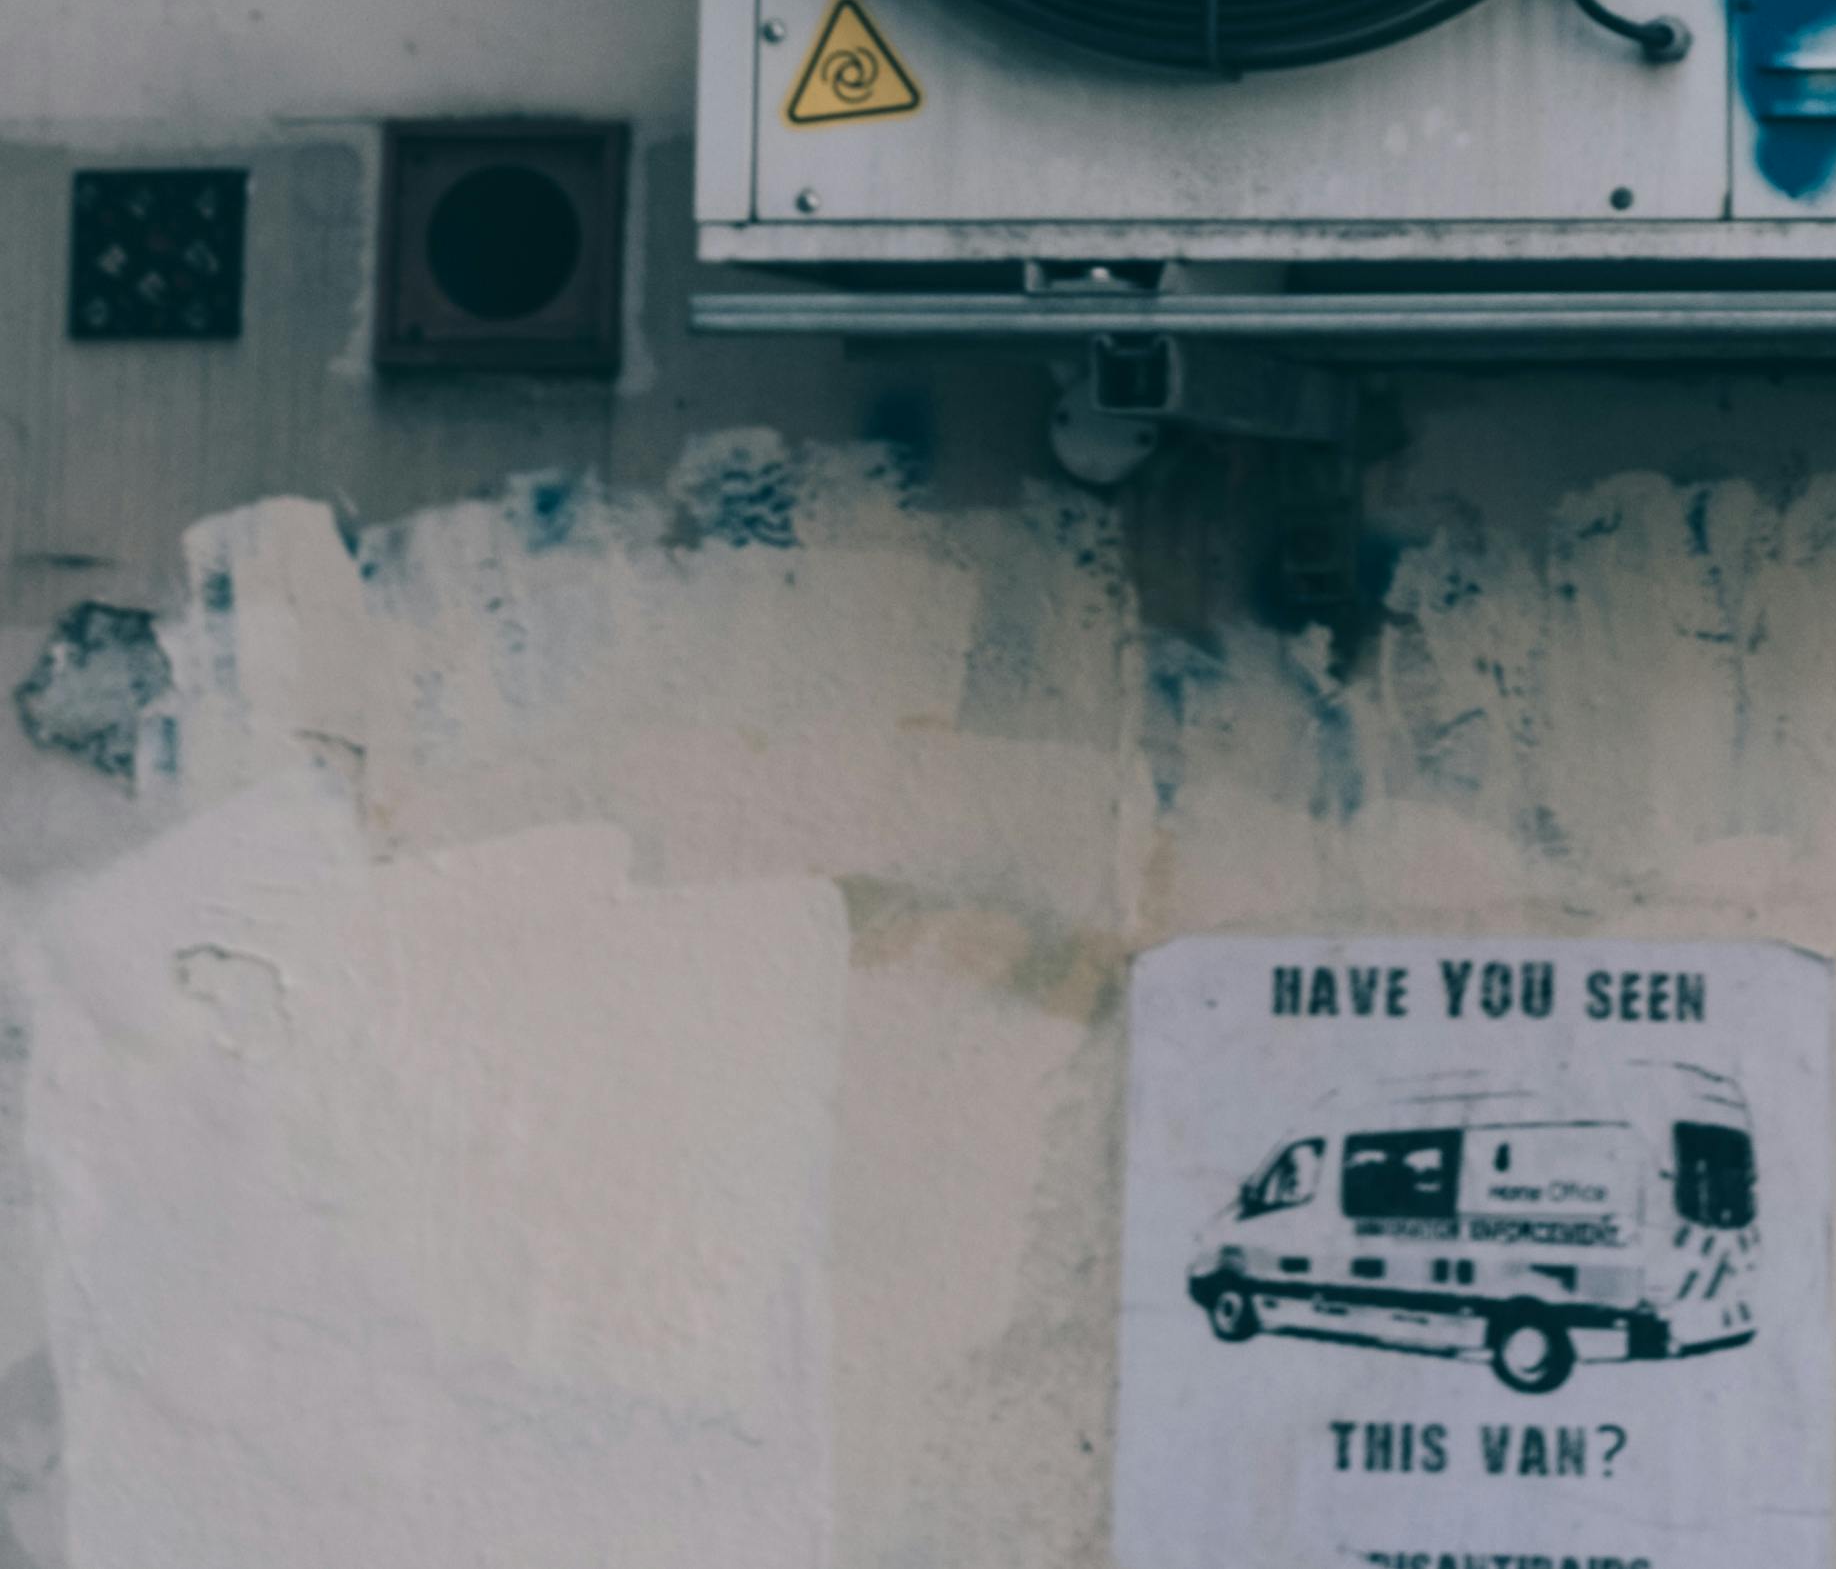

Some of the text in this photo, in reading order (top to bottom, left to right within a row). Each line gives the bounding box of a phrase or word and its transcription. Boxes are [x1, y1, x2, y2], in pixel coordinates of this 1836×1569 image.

[1272, 959, 1705, 1023] HAVE YOU SEEN
[1329, 1420, 1627, 1478] THIS VAN?
